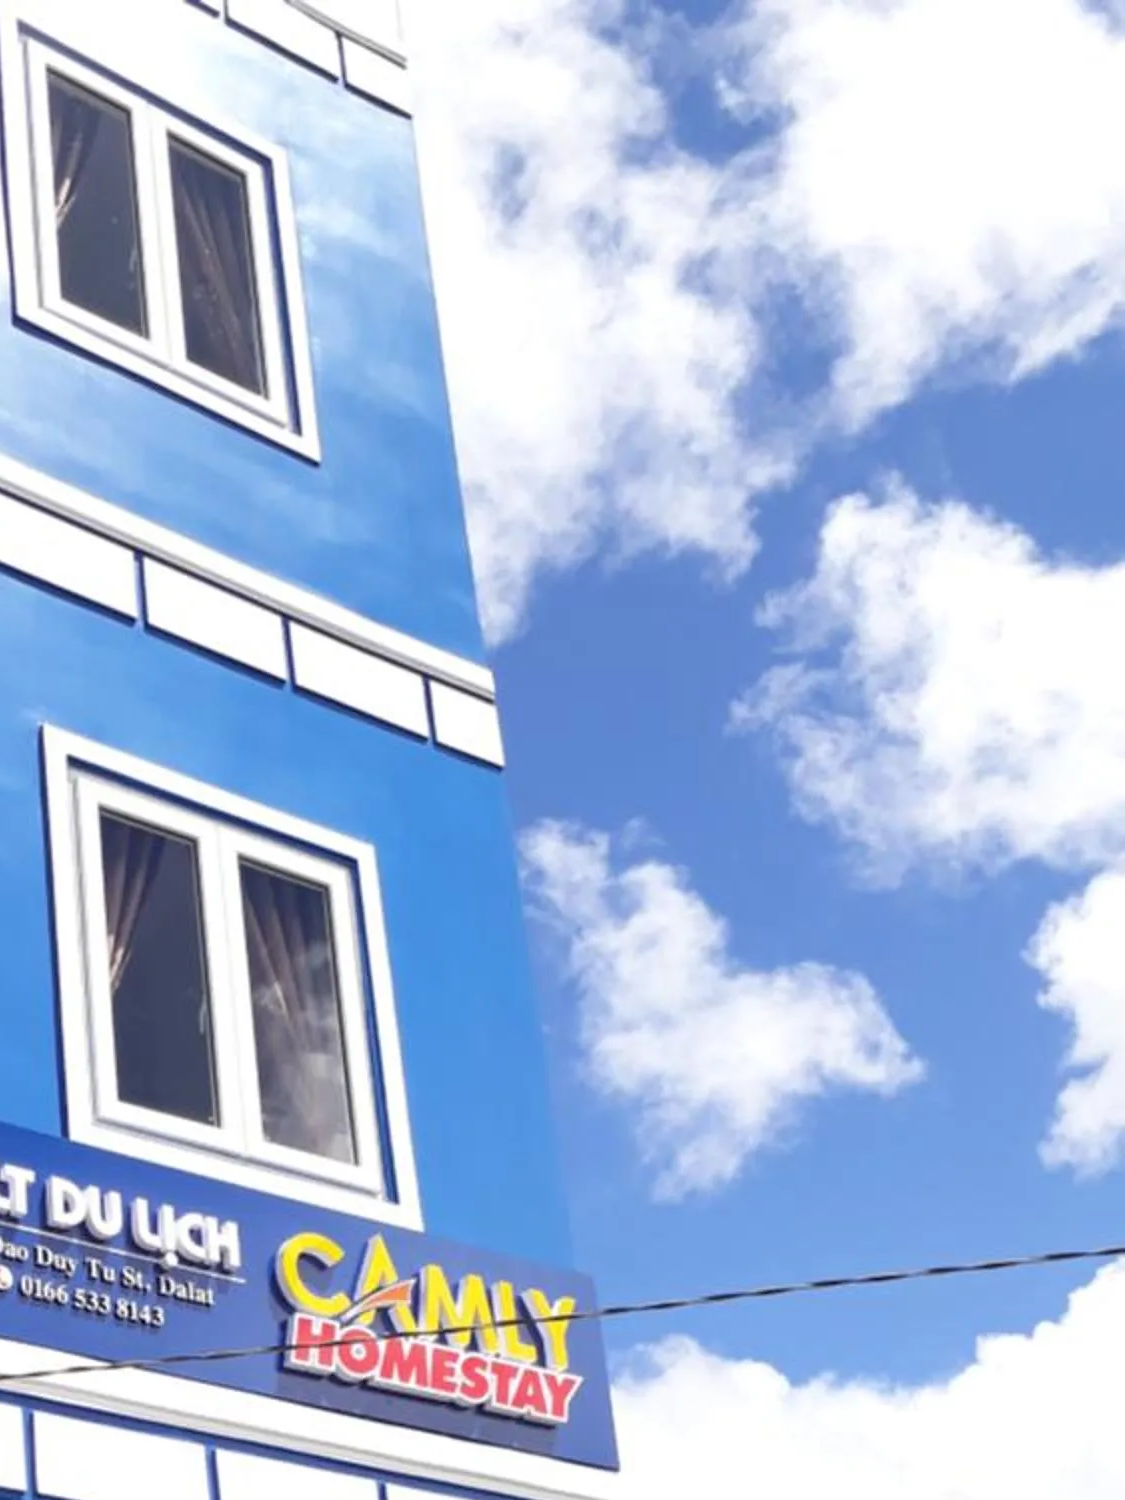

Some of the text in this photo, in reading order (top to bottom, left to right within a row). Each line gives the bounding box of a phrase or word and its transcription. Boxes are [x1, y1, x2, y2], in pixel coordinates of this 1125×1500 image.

[46, 1175, 123, 1240] DU
[131, 1196, 242, 1271] LỊCH
[20, 1275, 166, 1327] 0166 533 8143
[36, 1245, 77, 1278] Duy
[85, 1256, 116, 1283] Tu
[159, 1275, 216, 1306] Dalat
[275, 1231, 576, 1371] CAMLY
[285, 1311, 583, 1423] HOMESTAY
